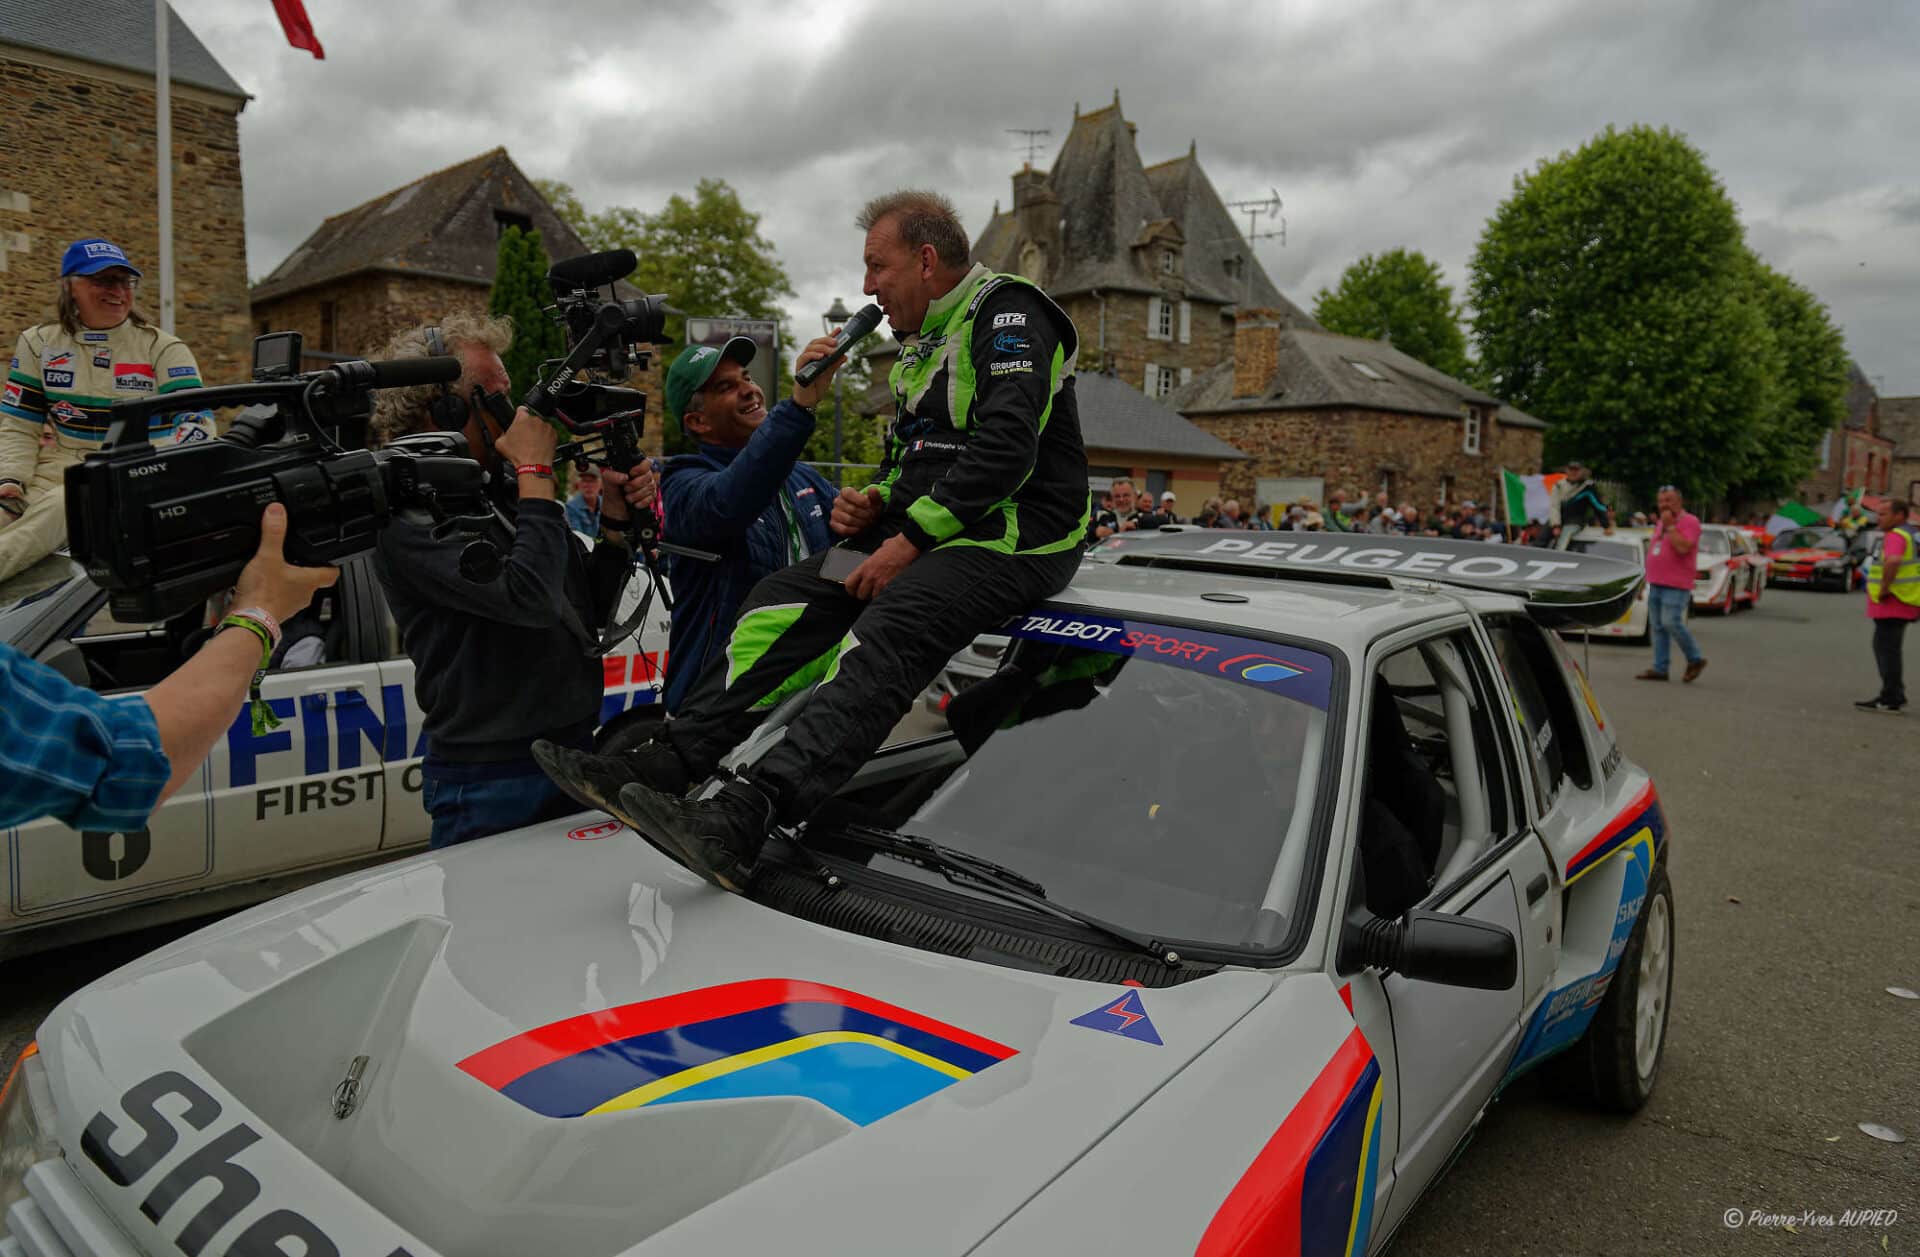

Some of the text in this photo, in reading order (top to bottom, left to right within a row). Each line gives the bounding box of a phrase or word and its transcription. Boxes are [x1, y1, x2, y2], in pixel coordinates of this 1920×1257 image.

[990, 361, 1021, 370] GROUPE
[46, 371, 72, 384] ERG
[115, 376, 154, 388] Marlboro
[547, 366, 573, 395] RONIN
[128, 462, 168, 478] SONY
[159, 504, 187, 520] HD
[1198, 538, 1579, 581] PEUGEOT
[1021, 616, 1122, 642] TALBOT
[1120, 631, 1219, 662] SPORT
[256, 770, 386, 820] FIRST
